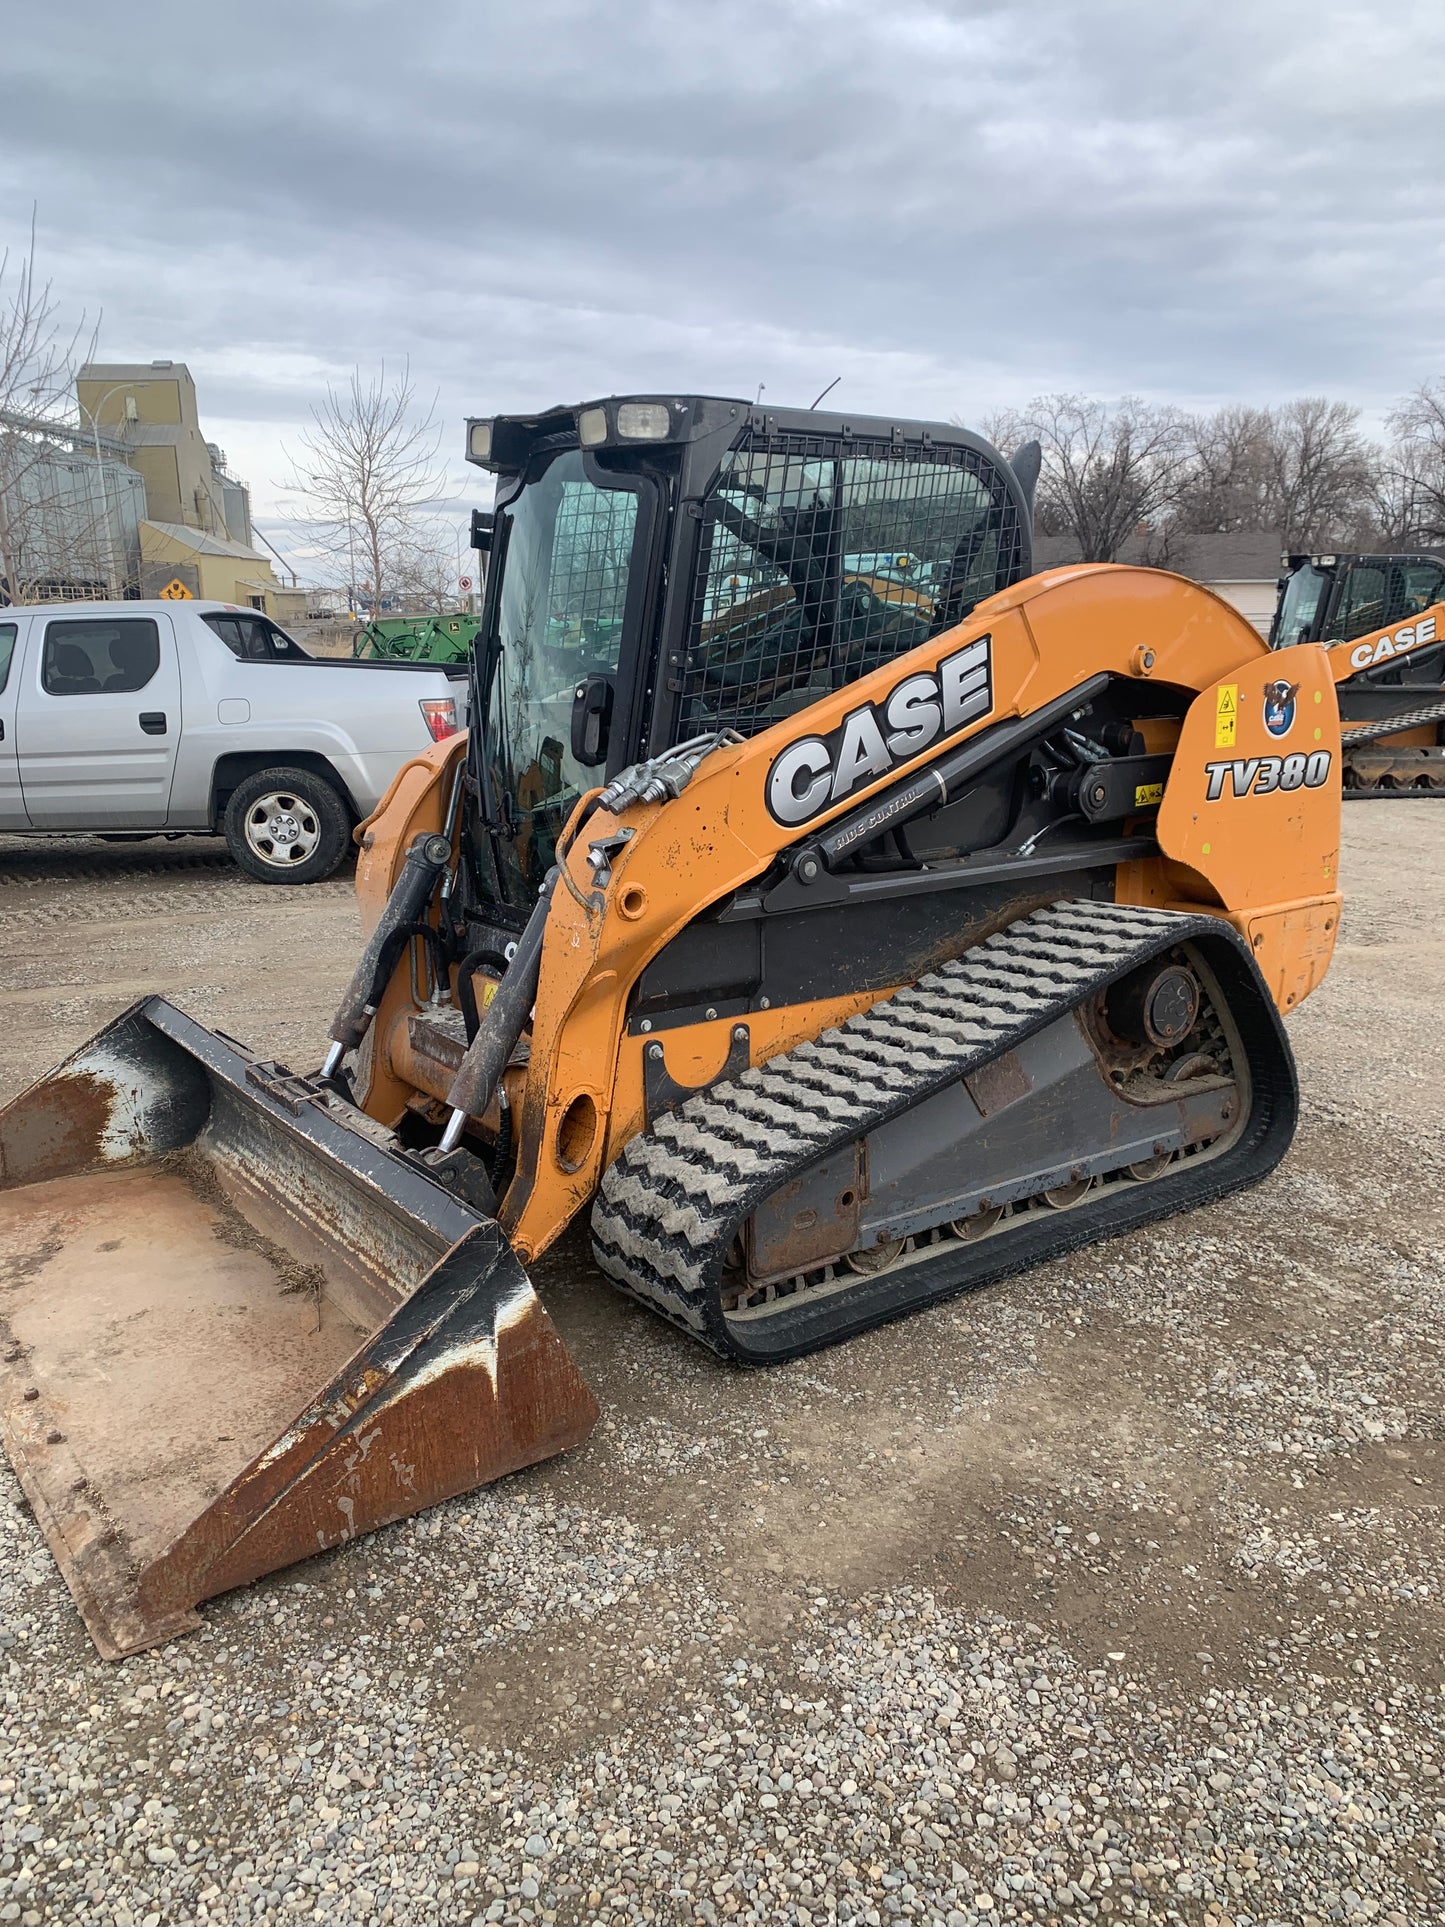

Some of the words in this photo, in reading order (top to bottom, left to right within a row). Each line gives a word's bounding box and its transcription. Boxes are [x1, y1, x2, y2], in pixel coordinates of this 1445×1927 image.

[1350, 616, 1436, 668] CASE
[766, 634, 993, 826] CASE
[1205, 750, 1332, 800] TV380
[835, 823, 866, 851] RIDE
[868, 786, 925, 829] CONTROL
